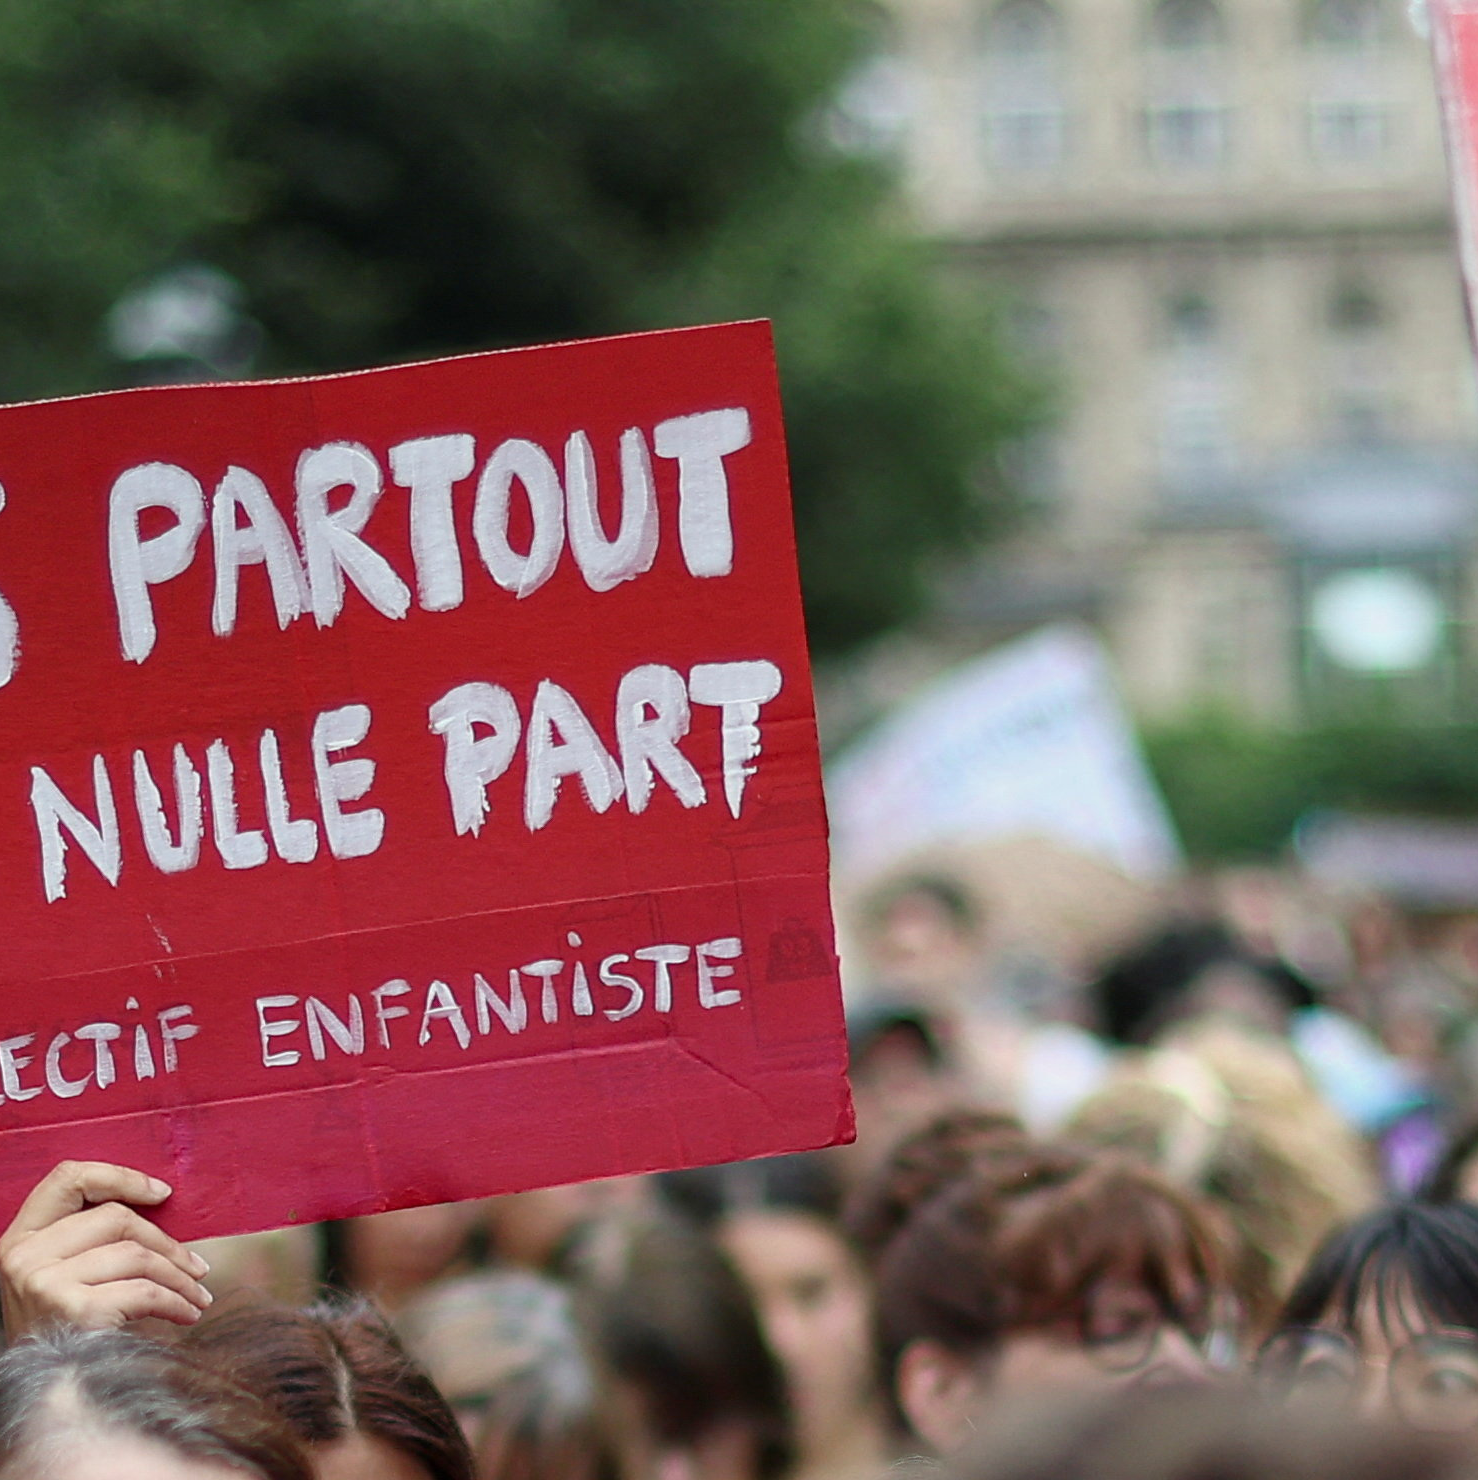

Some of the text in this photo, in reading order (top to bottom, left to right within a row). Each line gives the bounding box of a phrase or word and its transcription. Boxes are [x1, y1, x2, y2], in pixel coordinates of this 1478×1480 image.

[108, 407, 751, 665] PARTOUT
[30, 704, 385, 904] NULLE
[428, 659, 784, 840] PART
